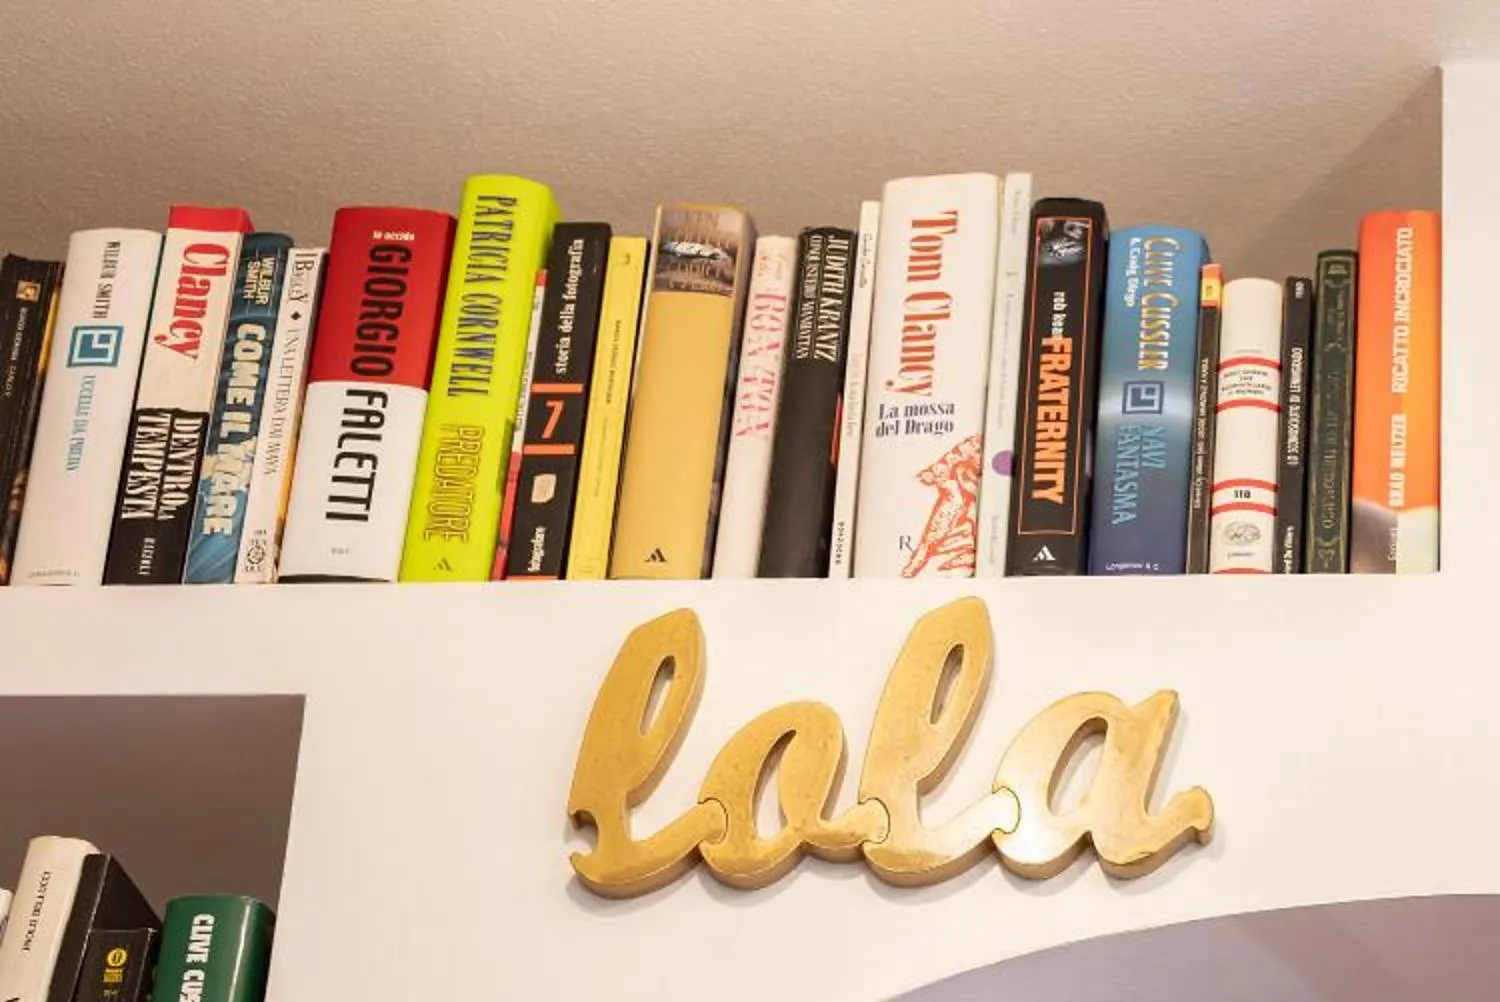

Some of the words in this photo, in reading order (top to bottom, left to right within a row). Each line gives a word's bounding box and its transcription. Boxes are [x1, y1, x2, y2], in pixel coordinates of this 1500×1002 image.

[100, 241, 120, 279] WILBUR
[465, 195, 518, 283] PATRICIA
[562, 238, 585, 300] fotografia
[822, 234, 849, 294] JUDITH
[906, 211, 960, 283] Tom
[1124, 247, 1139, 276] Craig
[1141, 236, 1181, 288] CLIVE
[93, 283, 113, 319] SMITH
[154, 243, 230, 361] Clancy
[243, 260, 261, 301] SMITH
[254, 256, 275, 305] WILBUR
[1051, 292, 1067, 311] rob
[1395, 227, 1413, 321] INCROCIATO
[350, 244, 414, 377] GIORGIO
[558, 303, 576, 333] della
[746, 292, 788, 361] BON
[795, 301, 815, 360] MANHATTAN
[813, 296, 843, 362] KRANTZ
[1136, 292, 1179, 371] CUSSLER
[224, 323, 266, 405] COME
[447, 292, 501, 397] CORNWELL
[555, 335, 570, 375] storia
[885, 292, 955, 397] Clancy
[1391, 324, 1411, 393] RICATTO
[274, 356, 295, 414] LETTERA
[734, 370, 778, 441] TON
[878, 404, 900, 420] La
[903, 403, 956, 417] mossa
[222, 412, 258, 437] IL
[876, 422, 899, 438] del
[901, 420, 956, 437] Drago
[1031, 336, 1072, 504] FRATERNITY
[1145, 425, 1166, 469] NAVI
[120, 413, 172, 520] TEMPESTA
[163, 416, 203, 505] DENTRO
[325, 389, 389, 522] FALETTI
[423, 424, 485, 543] PREDATORE
[1111, 425, 1141, 525] FANTASMA
[1388, 471, 1404, 506] BRAD
[203, 442, 256, 537] MARE
[569, 596, 1214, 897] lola
[185, 913, 215, 962] CLIVE
